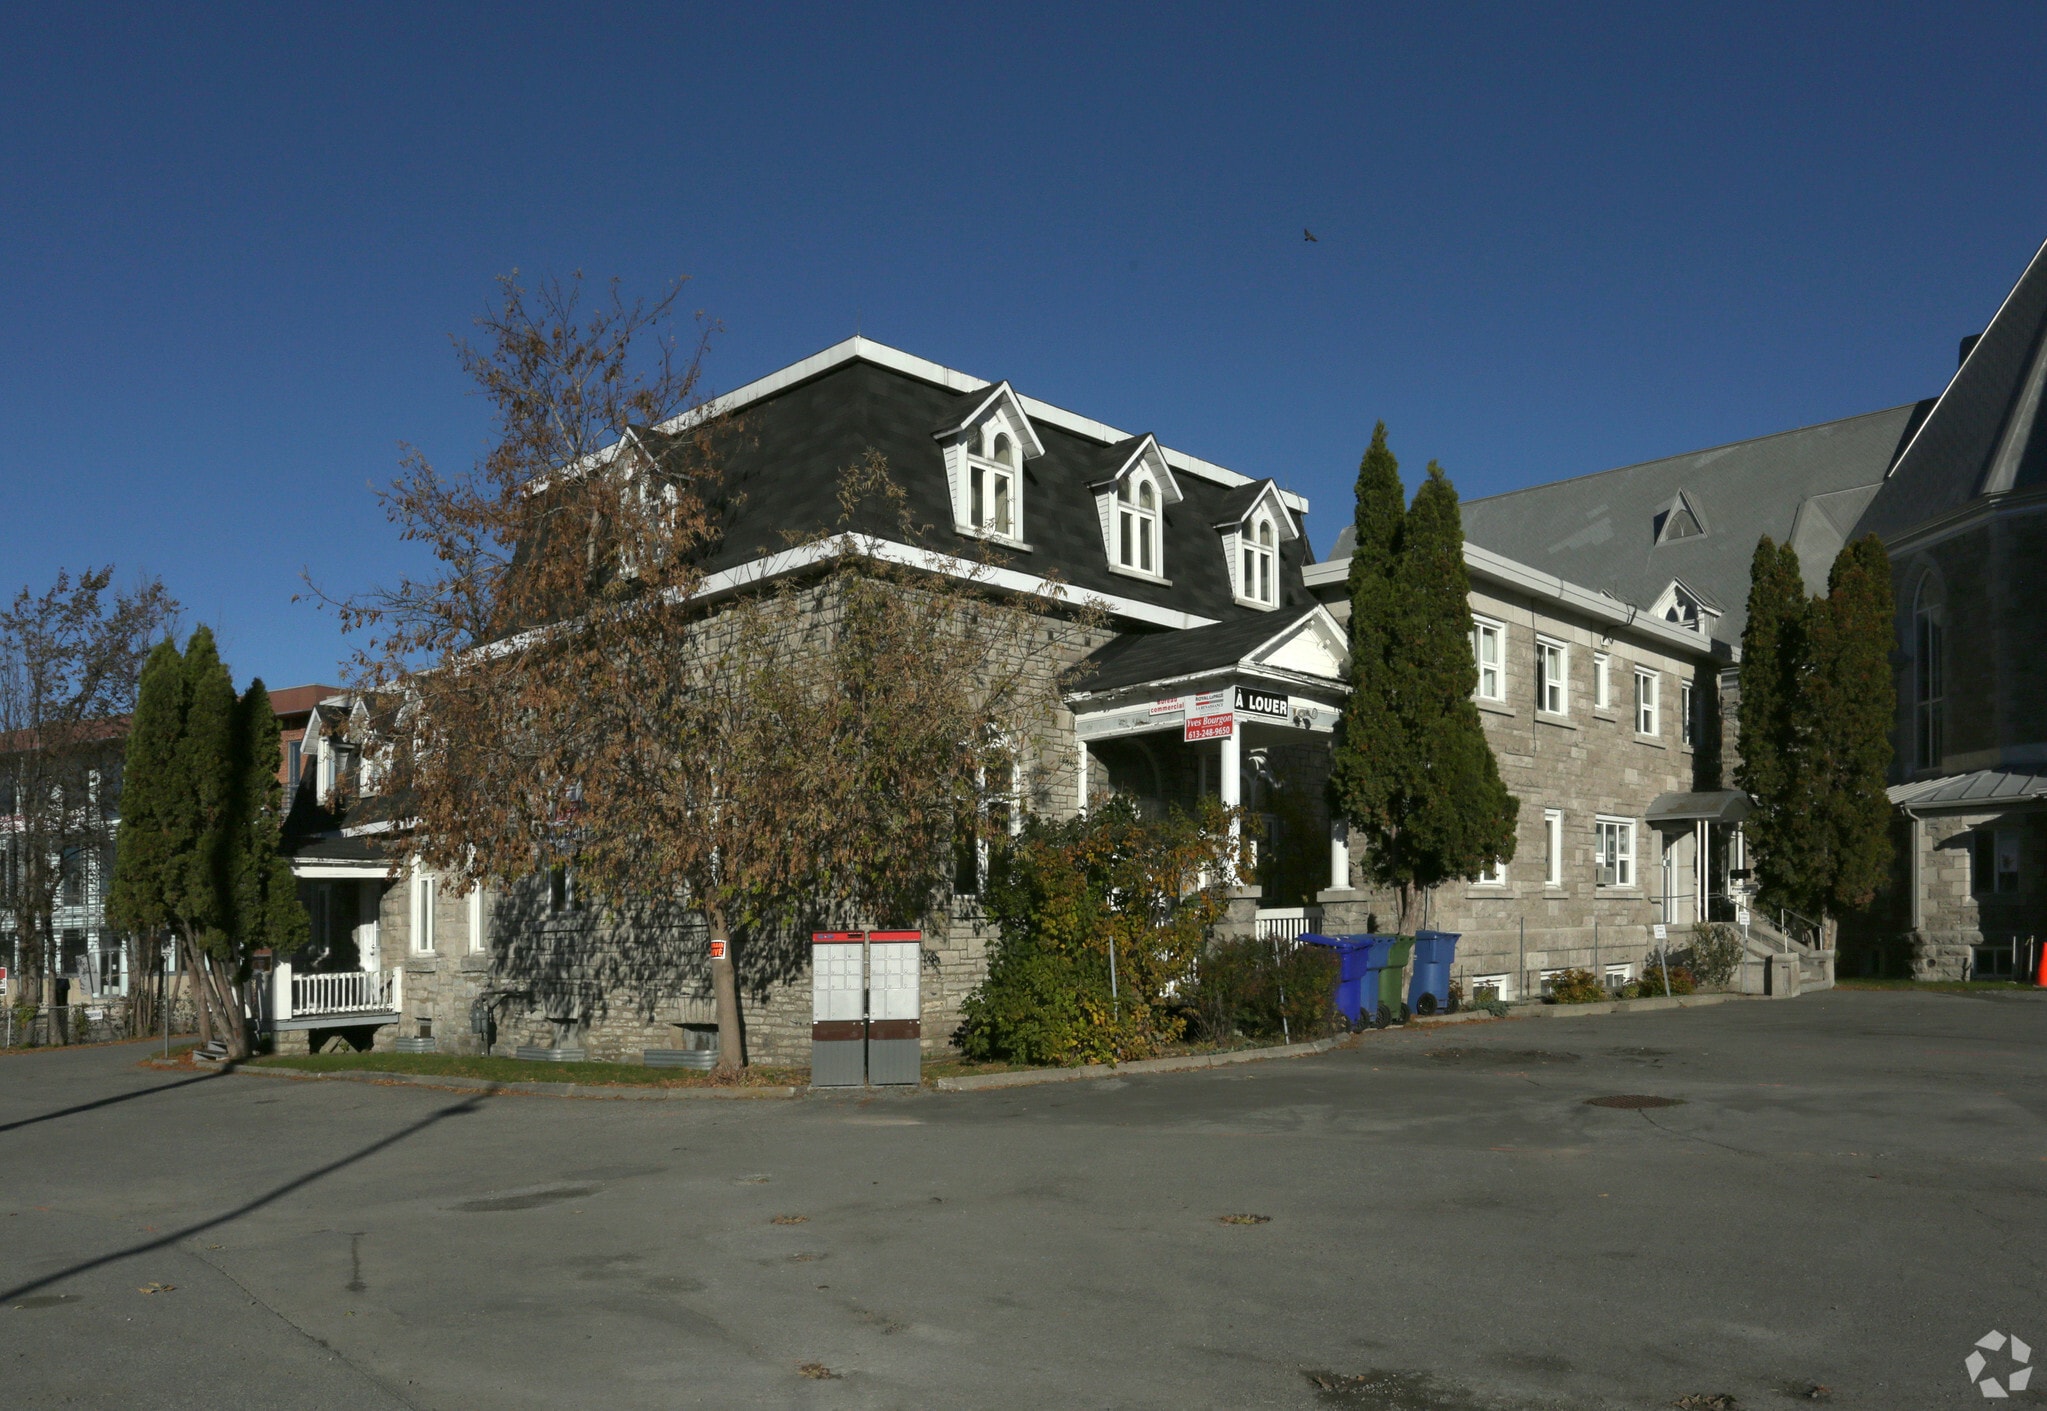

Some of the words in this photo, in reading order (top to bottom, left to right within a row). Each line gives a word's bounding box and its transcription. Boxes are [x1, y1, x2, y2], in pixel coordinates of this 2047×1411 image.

[1150, 702, 1185, 713] commercial
[1236, 689, 1244, 708] À
[1249, 695, 1288, 715] LOUER
[1187, 718, 1202, 728] Yves
[1202, 714, 1232, 726] Bourgon
[1188, 726, 1230, 739] 613-248-9650
